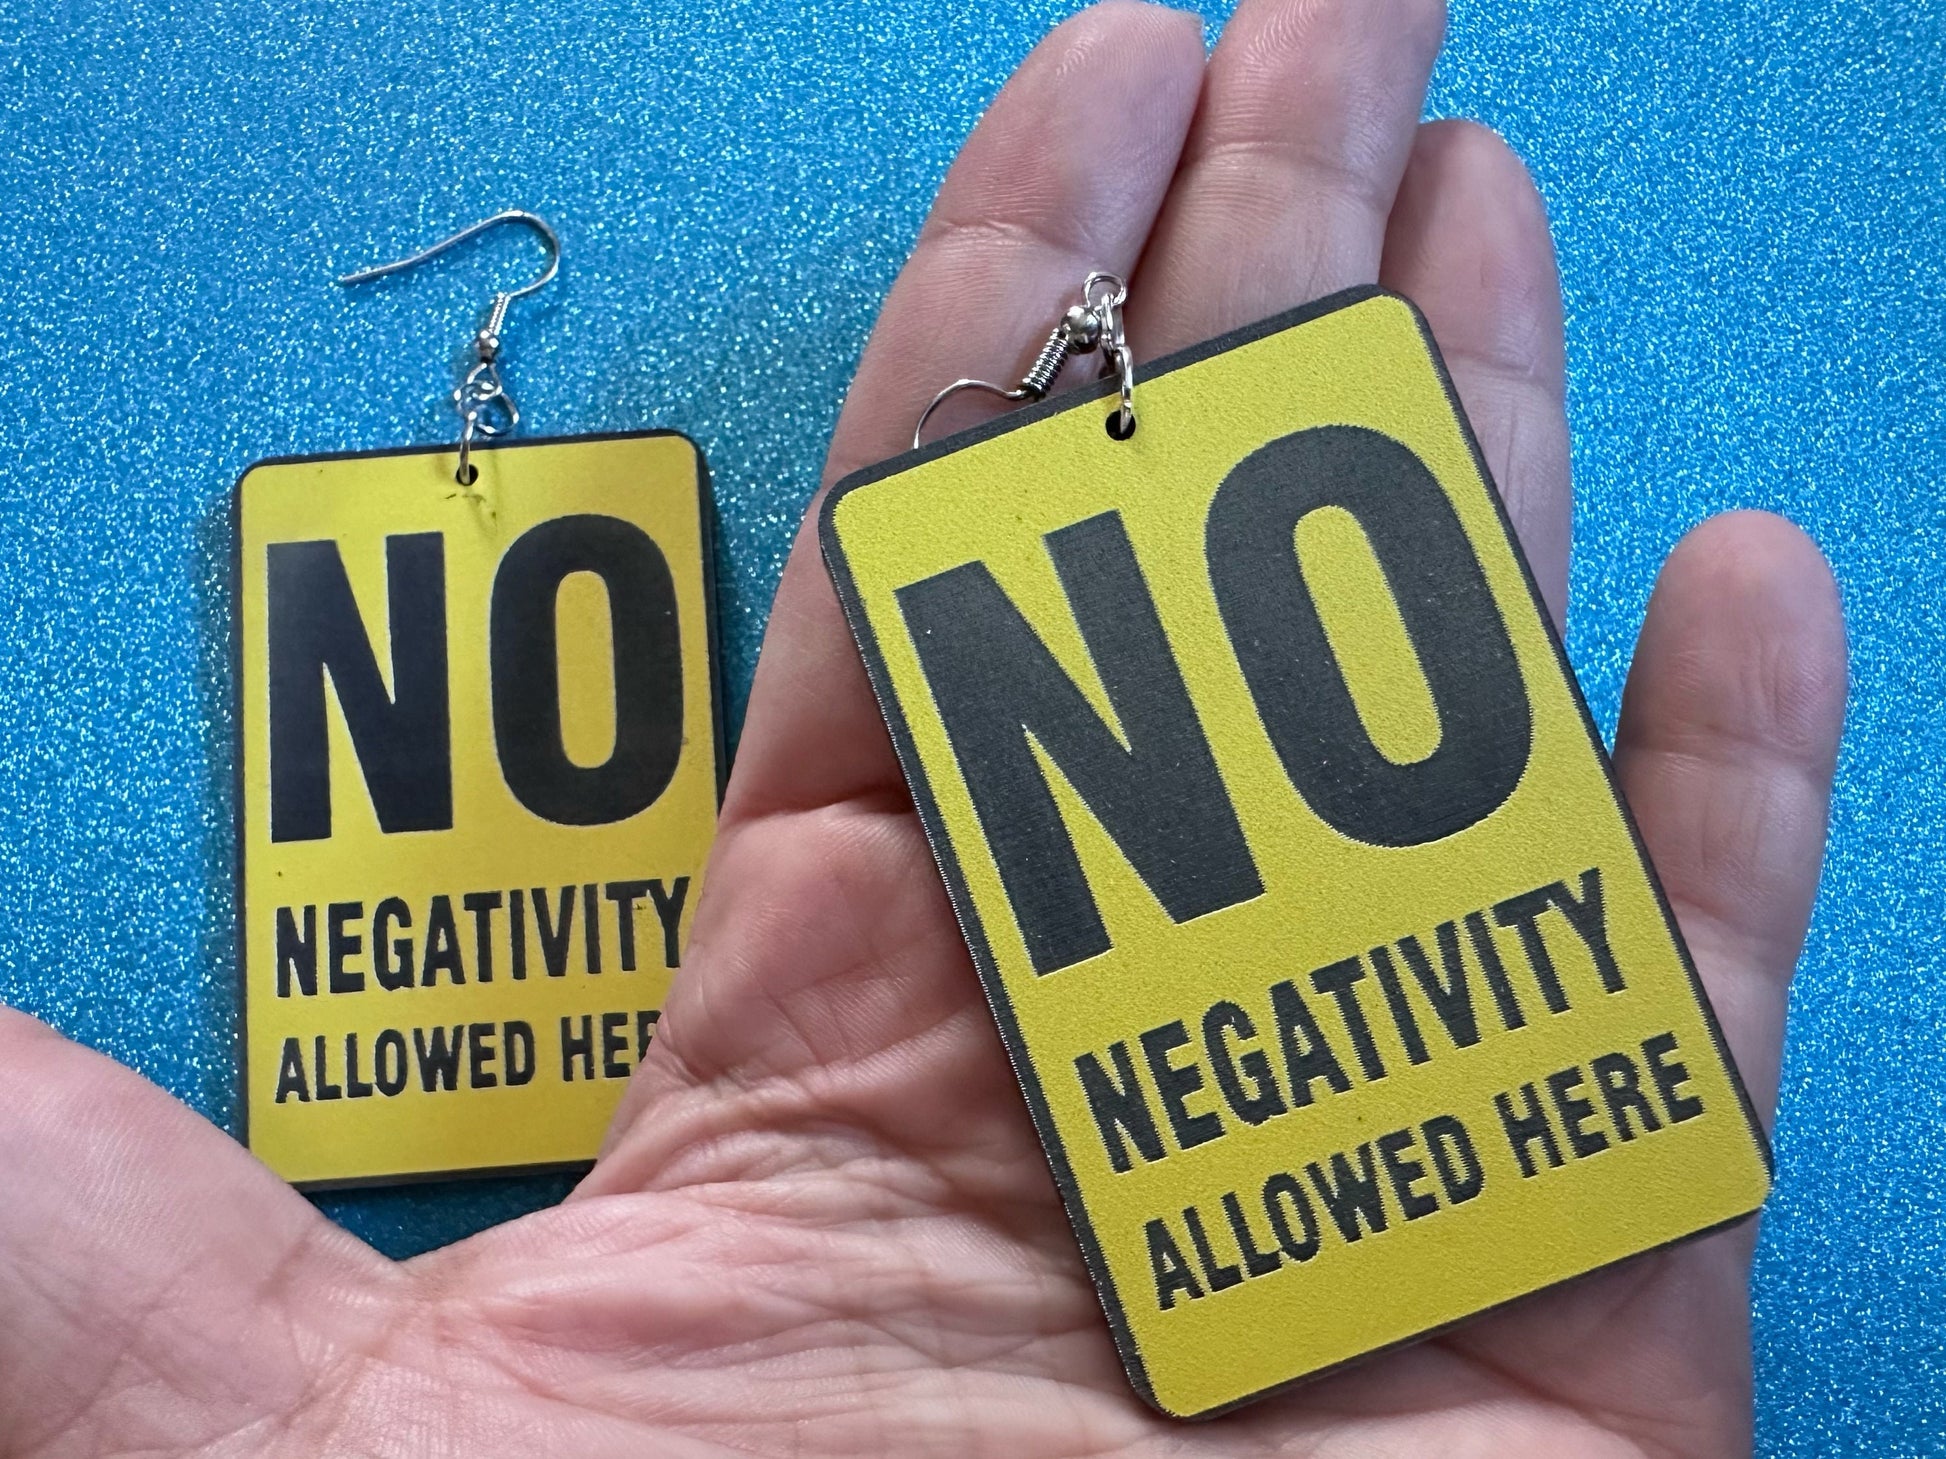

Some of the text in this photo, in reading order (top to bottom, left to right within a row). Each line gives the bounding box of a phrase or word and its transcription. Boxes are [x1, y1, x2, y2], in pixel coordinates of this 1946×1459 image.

[266, 513, 685, 844] NO
[892, 424, 1534, 977] NO
[275, 1020, 536, 1104] ALLOWED
[276, 876, 691, 998] NEGATIVITY
[1073, 867, 1627, 1174] NEGATIVITY
[1142, 1030, 1704, 1311] ALLOWED HERE
